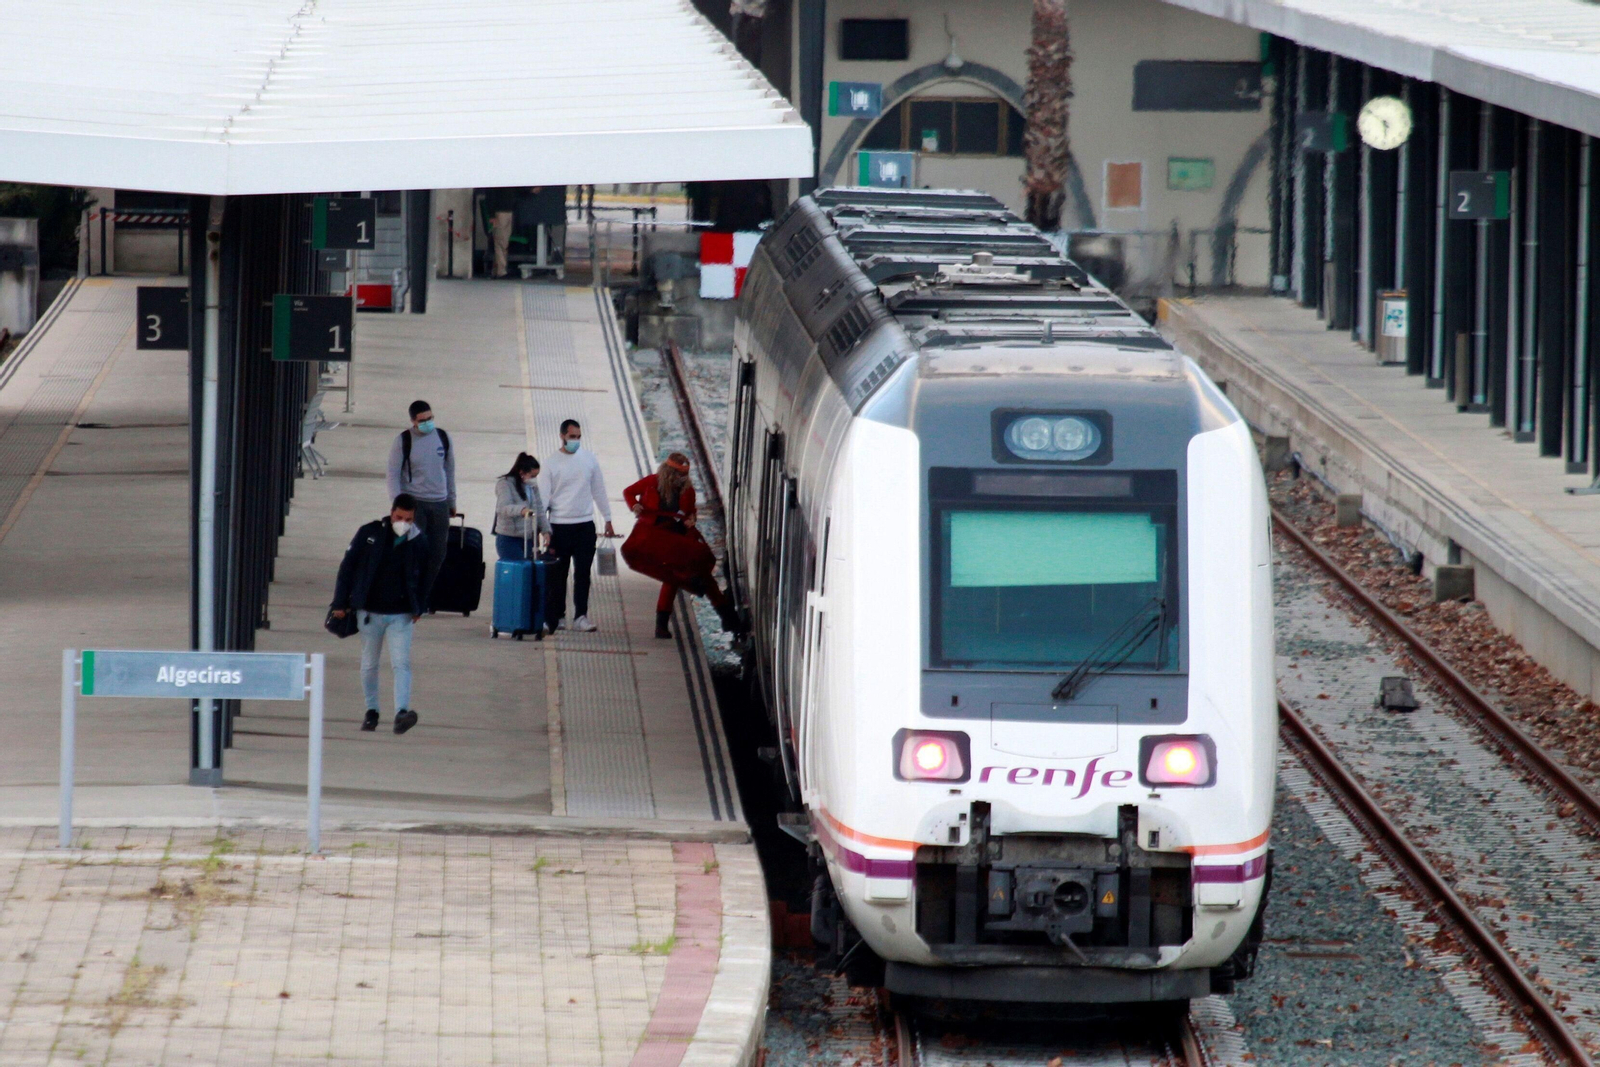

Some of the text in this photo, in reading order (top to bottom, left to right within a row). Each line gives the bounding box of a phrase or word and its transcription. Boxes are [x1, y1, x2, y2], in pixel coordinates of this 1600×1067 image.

[1457, 192, 1469, 212] 2
[356, 221, 370, 243] 1
[146, 314, 161, 342] 3
[328, 325, 345, 353] 1
[156, 665, 242, 687] Algeciras
[978, 756, 1133, 800] renfe
